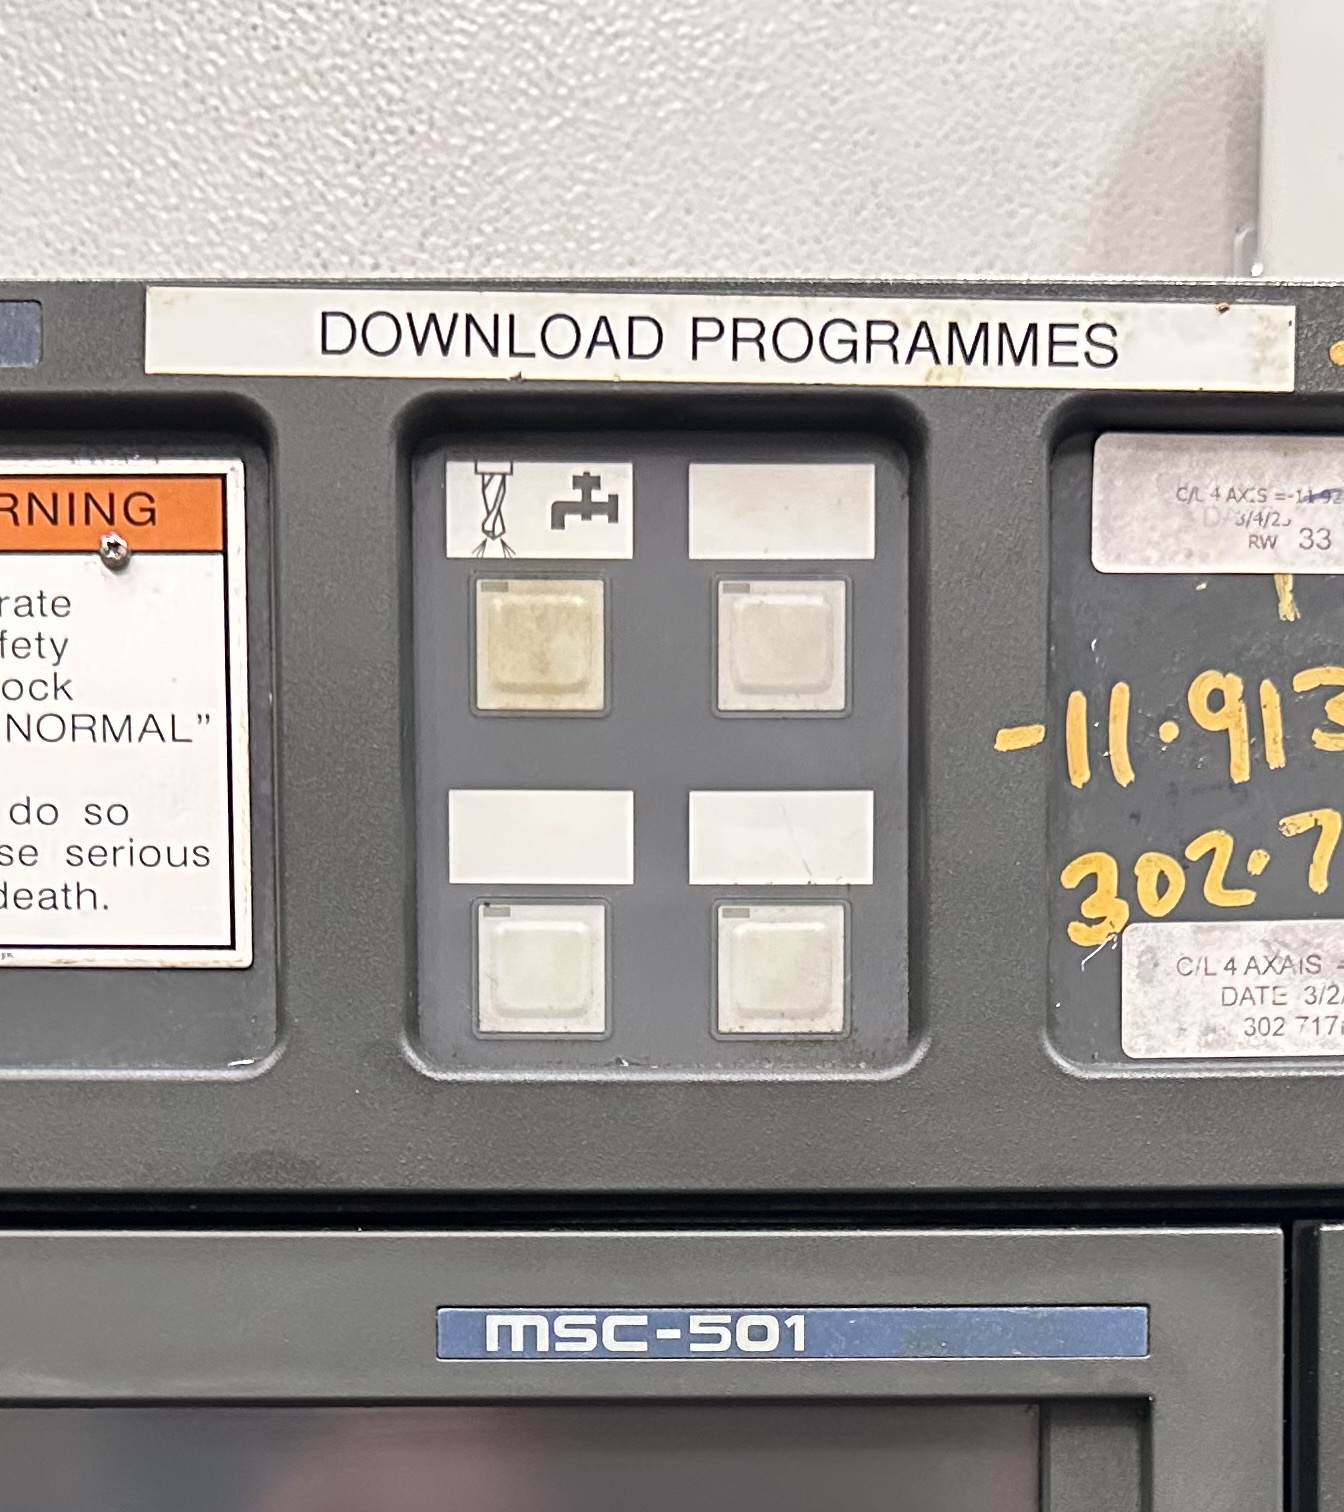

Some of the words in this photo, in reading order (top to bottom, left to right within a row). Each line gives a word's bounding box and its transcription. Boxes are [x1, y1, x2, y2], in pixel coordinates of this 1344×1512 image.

[321, 310, 664, 360] DOWNLOAD
[691, 316, 1119, 369] PROGRAMMES
[1210, 488, 1220, 498] 4
[1248, 534, 1278, 550] RW
[1299, 527, 1332, 550] 33
[9, 795, 59, 826] do
[84, 803, 129, 826] so
[65, 837, 210, 868] serious
[1176, 954, 1217, 978] C/L
[1223, 955, 1237, 977] 4
[1244, 954, 1323, 977] AXAIS
[1222, 985, 1288, 1007] DATE
